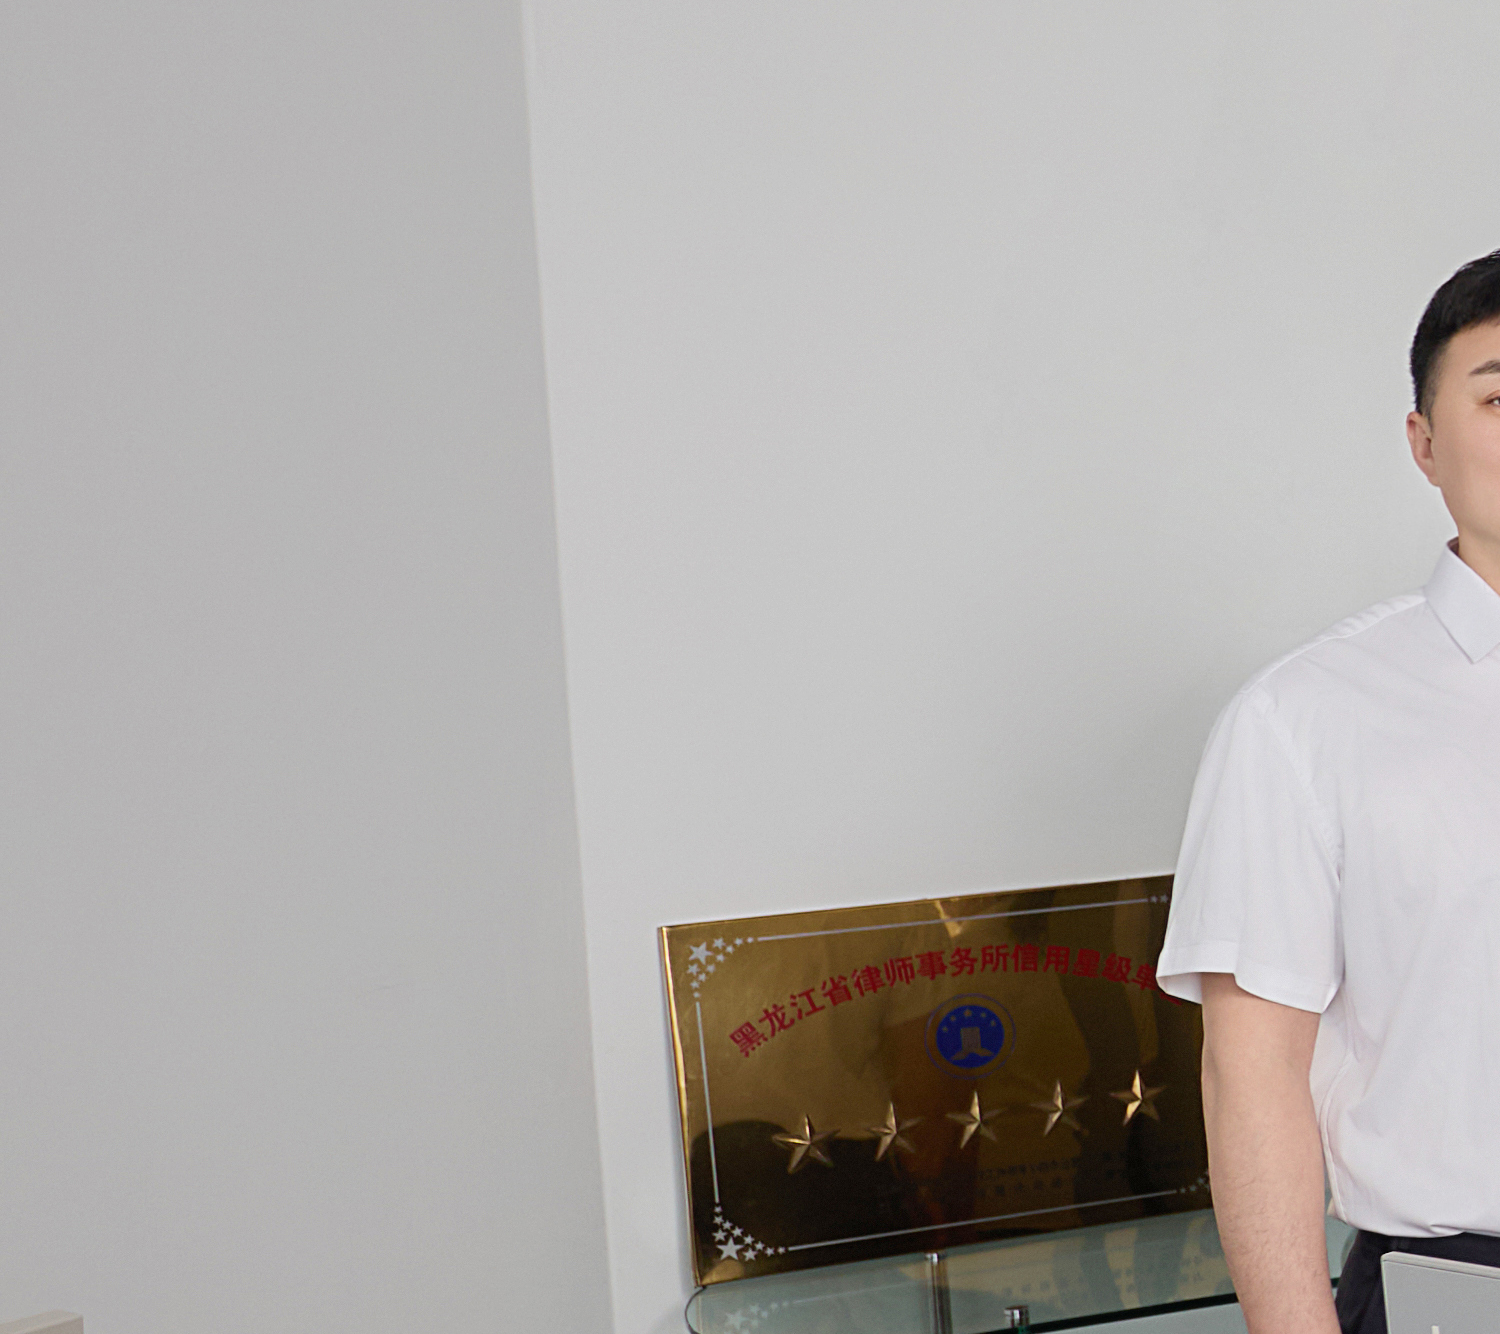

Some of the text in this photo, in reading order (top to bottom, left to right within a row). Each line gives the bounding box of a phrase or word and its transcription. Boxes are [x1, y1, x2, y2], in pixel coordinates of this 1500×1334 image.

[729, 942, 1183, 1057] 黑龙江省律师事务所信用星级单
